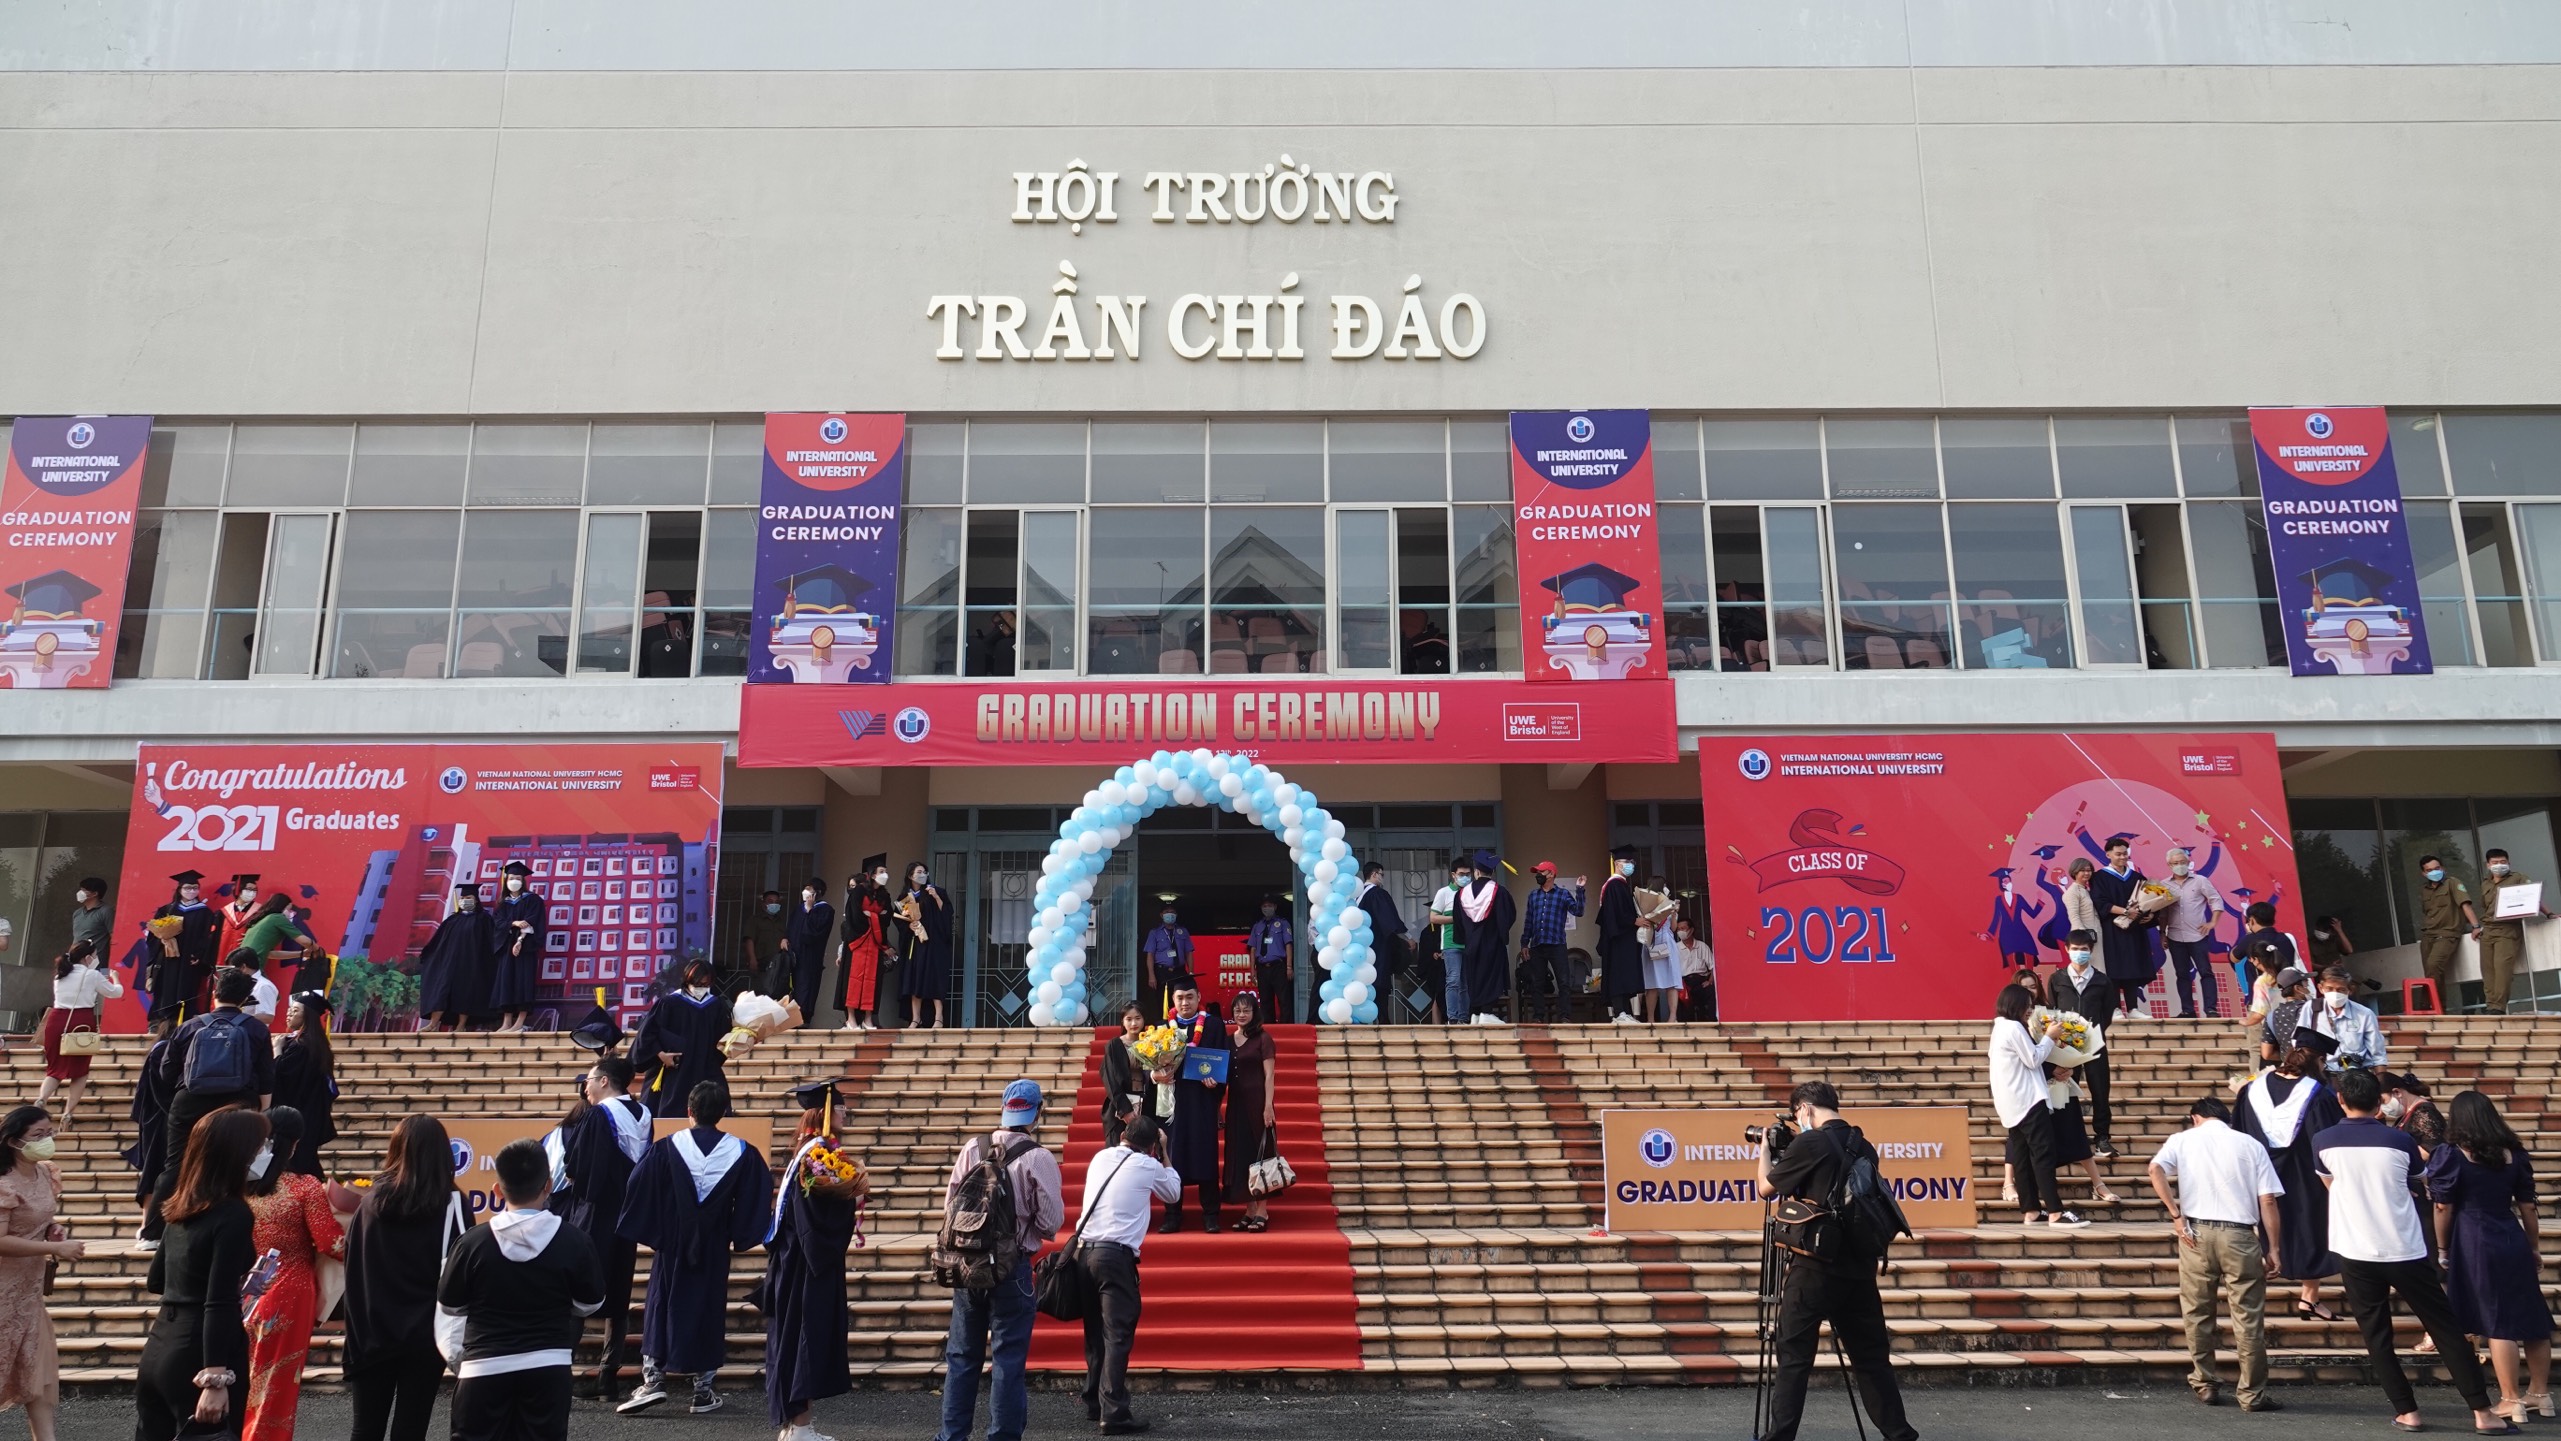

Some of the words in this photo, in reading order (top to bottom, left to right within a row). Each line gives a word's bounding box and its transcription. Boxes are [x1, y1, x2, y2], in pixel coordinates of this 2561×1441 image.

[1012, 157, 1119, 236] HỘI
[1144, 153, 1398, 223] TRƯỜNG
[926, 259, 1147, 360] TRẦN
[1167, 272, 1304, 360] CHÍ
[1331, 274, 1486, 360] ĐÁO
[786, 451, 877, 462] INTERNATIONAL
[1537, 449, 1627, 462] INTERNATIONAL
[2279, 445, 2368, 458] INTERNATIONAL
[32, 456, 120, 468] INTERNATIONAL
[2294, 460, 2361, 472] UNIVERSITY
[42, 471, 110, 482] UNIVERSITY
[799, 466, 867, 477] UNIVERSITY
[1551, 464, 1618, 476] UNIVERSITY
[762, 505, 894, 520] GRADUATION
[1520, 503, 1651, 520] GRADUATION
[2269, 500, 2398, 515] GRADUATION
[2, 511, 131, 526] GRADUATION
[772, 526, 883, 541] CEREMONY
[1532, 525, 1641, 541] CEREMONY
[2283, 520, 2390, 536] CEREMONY
[9, 532, 117, 546] CEREMONY
[976, 693, 1218, 744] GRADUATION
[1233, 691, 1441, 742] CEREMONY
[1510, 716, 1536, 724] UWE
[1510, 725, 1546, 735] Bristol
[1781, 754, 1818, 762] VIETNAM
[1781, 765, 1874, 775] INTERNATIONAL
[1876, 764, 1943, 774] UNIVERSITY
[164, 760, 407, 799] Congratulations
[475, 780, 558, 790] INTERNATIONAL
[561, 780, 622, 790] UNIVERSITY
[286, 808, 400, 830] Graduates
[157, 805, 279, 852] 2021
[1788, 853, 1841, 872] CLASS
[1845, 853, 1868, 870] OF
[1761, 906, 1896, 964] 2021
[1684, 1144, 1761, 1160] INTERNA
[1616, 1179, 1779, 1204] GRADUATI
